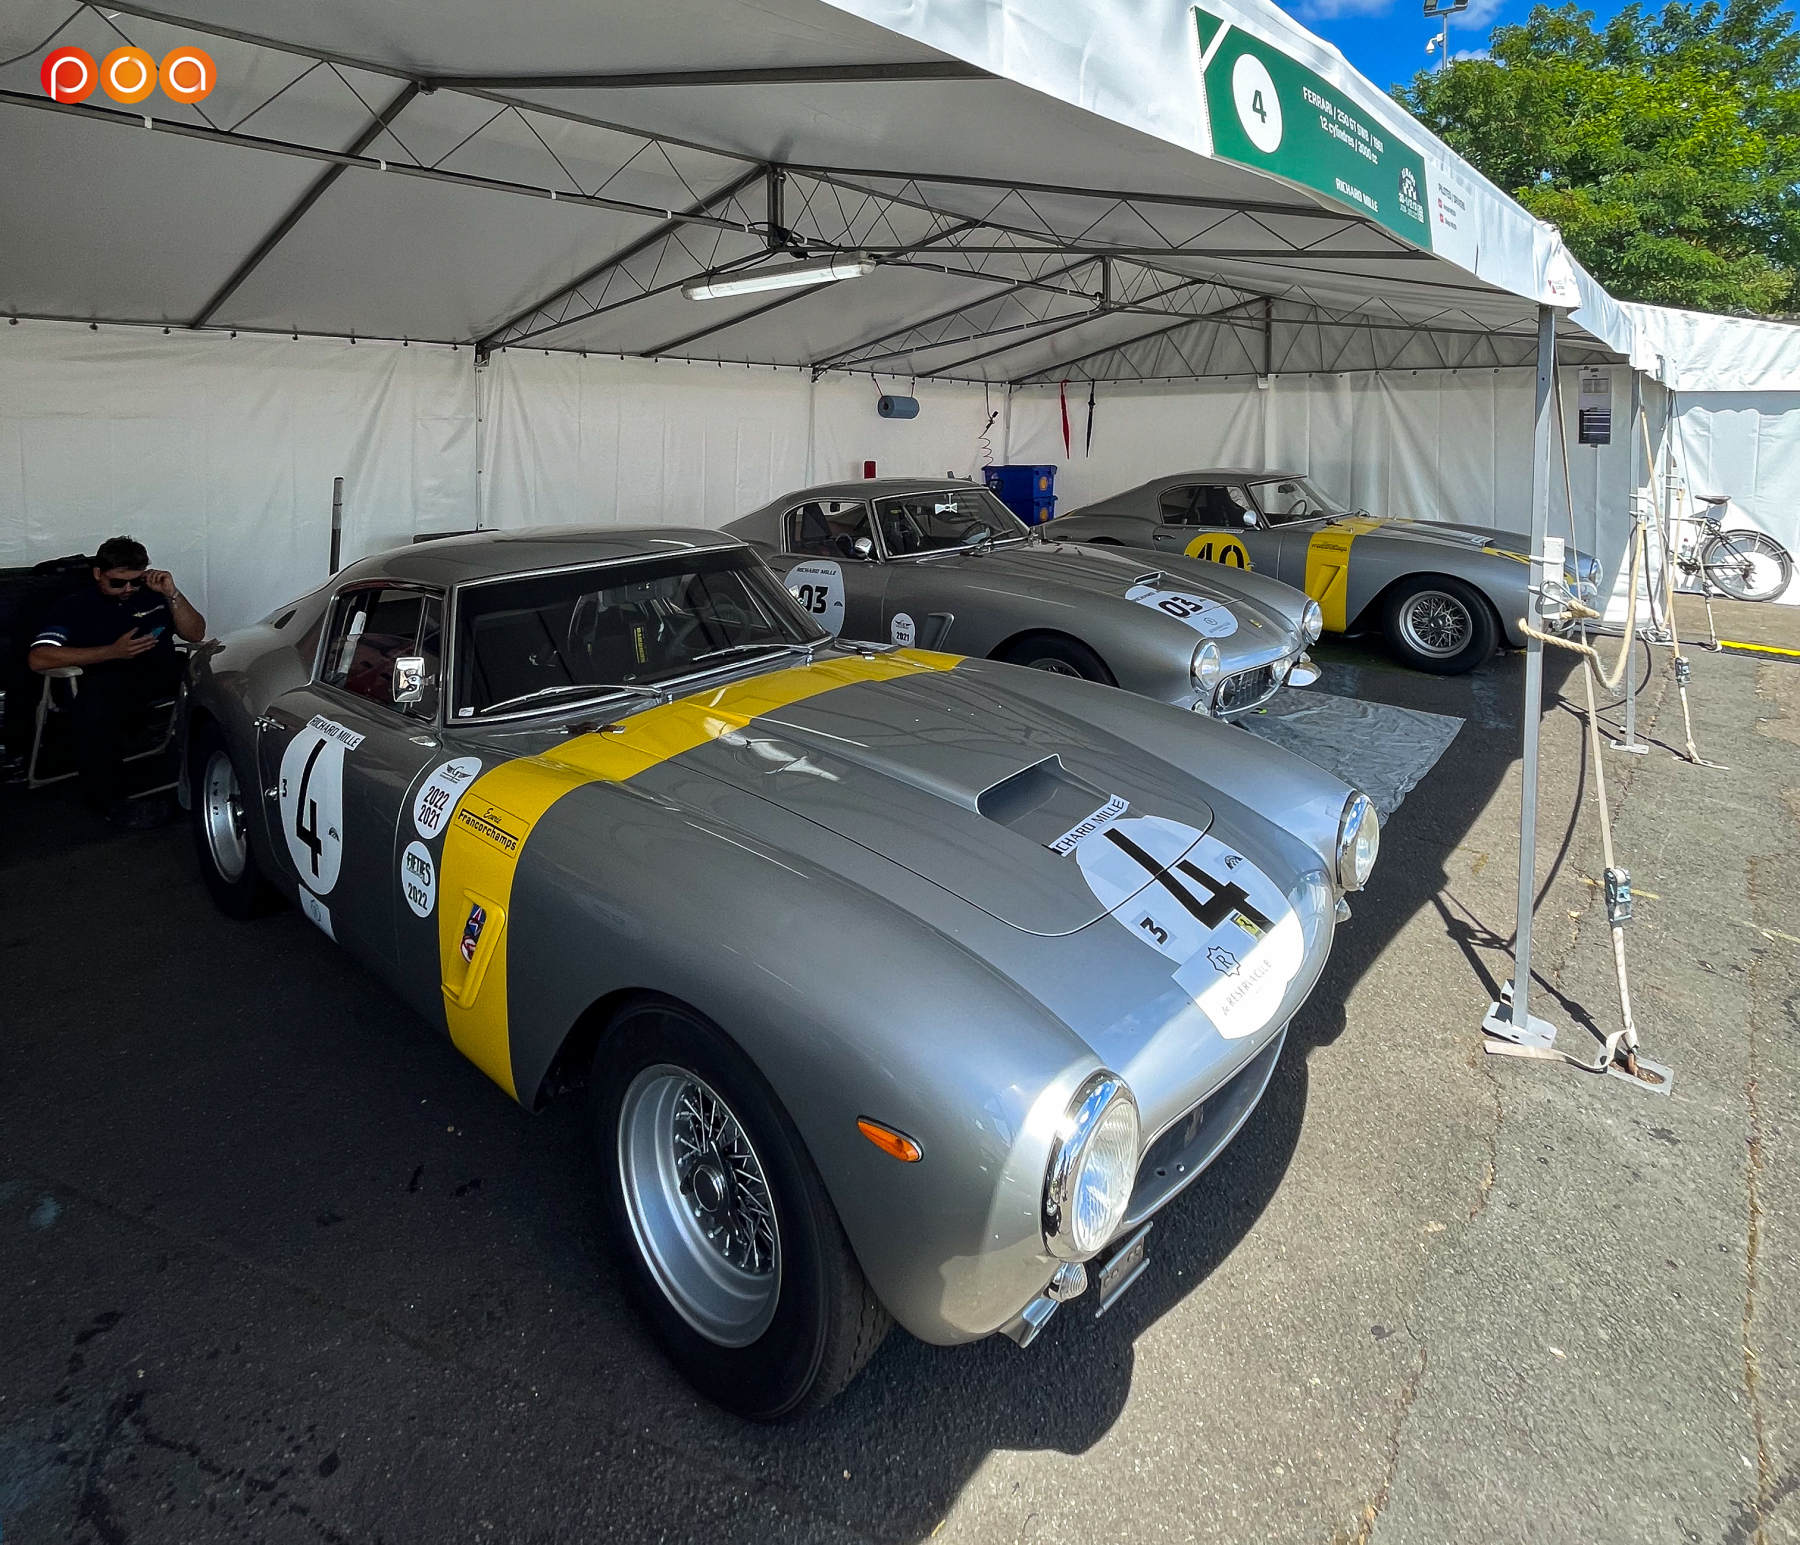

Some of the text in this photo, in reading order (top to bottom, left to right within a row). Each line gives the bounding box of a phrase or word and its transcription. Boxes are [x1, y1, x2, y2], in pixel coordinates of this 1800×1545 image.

[1252, 89, 1267, 124] 4
[1302, 86, 1333, 116] FERRARI
[1337, 108, 1350, 128] 250
[1349, 117, 1357, 133] GT
[1319, 115, 1329, 132] 12
[1335, 177, 1379, 213] RICHARD MILLE
[1197, 542, 1245, 569] 40
[799, 584, 829, 613] 03
[1158, 596, 1204, 618] 03
[896, 631, 910, 642] 2021
[310, 716, 361, 748] RICHARD MILLE
[295, 737, 328, 879] 4
[423, 785, 451, 812] 2022
[1090, 798, 1125, 825] MILLE
[417, 804, 441, 830] 2021
[457, 811, 517, 851] Francorchamps
[1103, 827, 1276, 934] 4
[407, 882, 428, 911] 2022
[1139, 916, 1168, 945] 3
